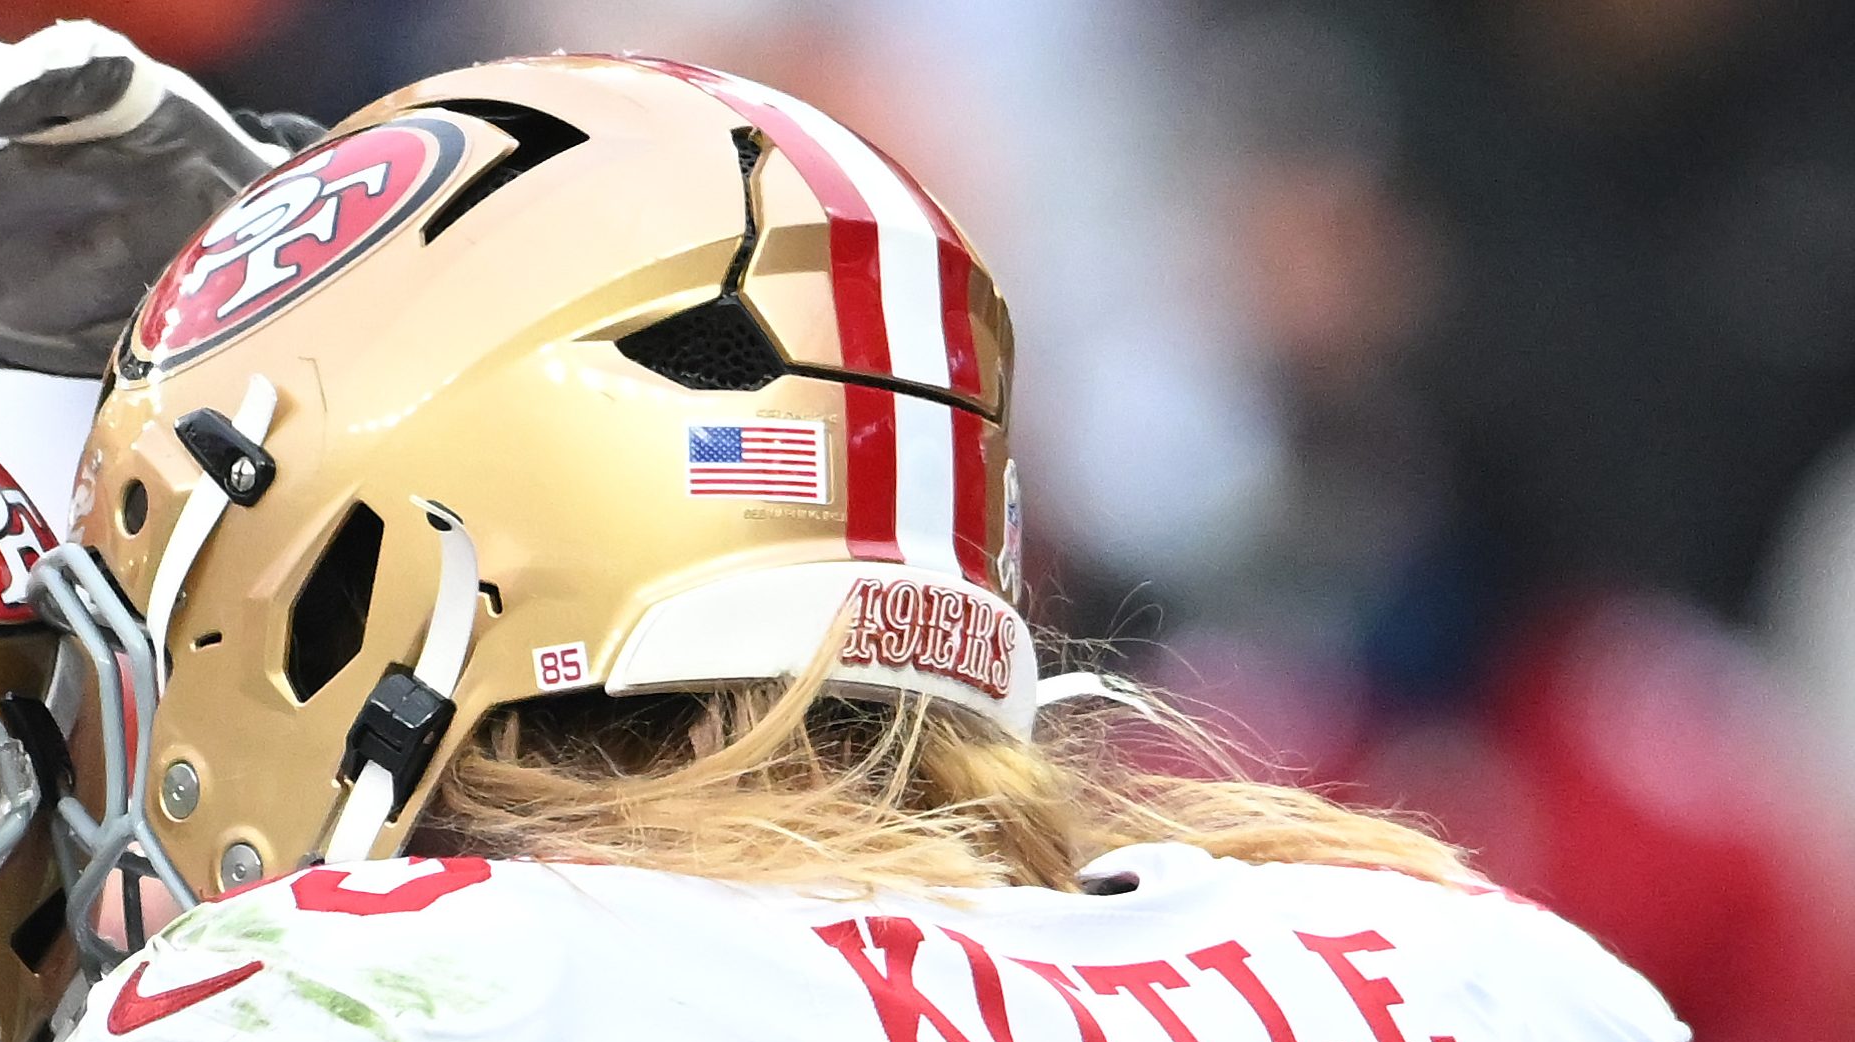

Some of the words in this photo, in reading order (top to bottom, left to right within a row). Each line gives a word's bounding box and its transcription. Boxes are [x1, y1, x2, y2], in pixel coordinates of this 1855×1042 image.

[178, 148, 393, 320] SF
[540, 648, 582, 685] 85
[841, 577, 1018, 700] 49ERS
